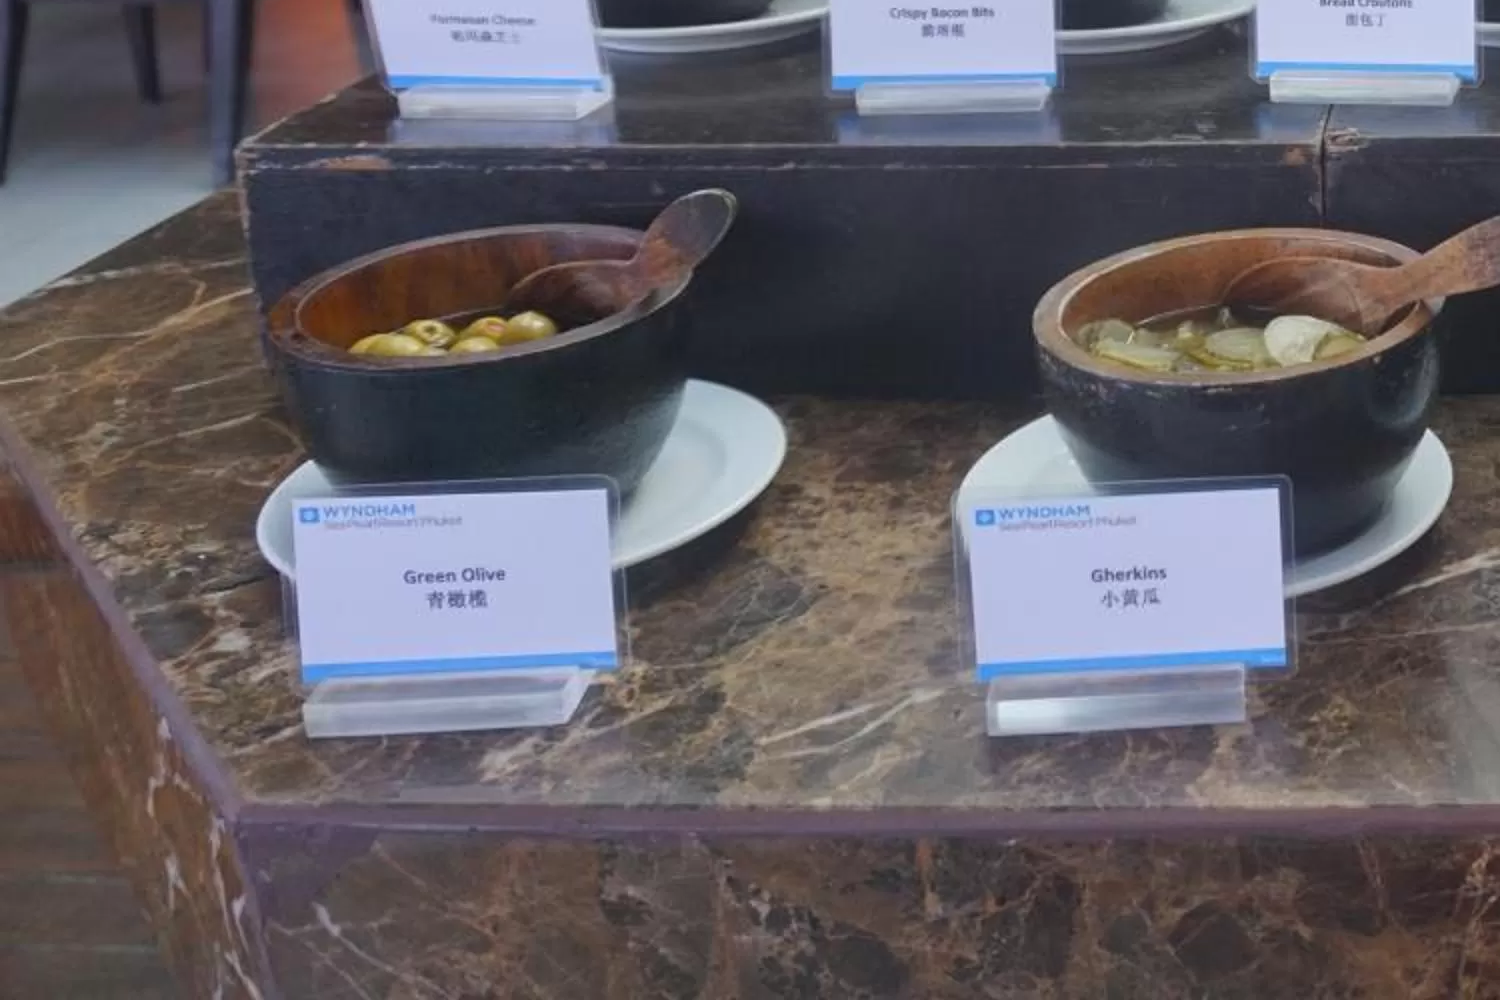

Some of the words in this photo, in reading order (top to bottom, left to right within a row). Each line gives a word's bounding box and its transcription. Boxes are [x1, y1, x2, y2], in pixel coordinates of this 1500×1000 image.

[889, 7, 928, 20] Crispy
[931, 7, 969, 18] Bacon
[971, 7, 995, 18] Bits
[323, 503, 416, 519] WYNDHAM
[999, 504, 1091, 519] WYNDHAM
[403, 569, 456, 585] Green
[462, 567, 506, 582] Olive
[1091, 566, 1168, 583] Gherkins
[1101, 588, 1161, 608] 小黄瓜
